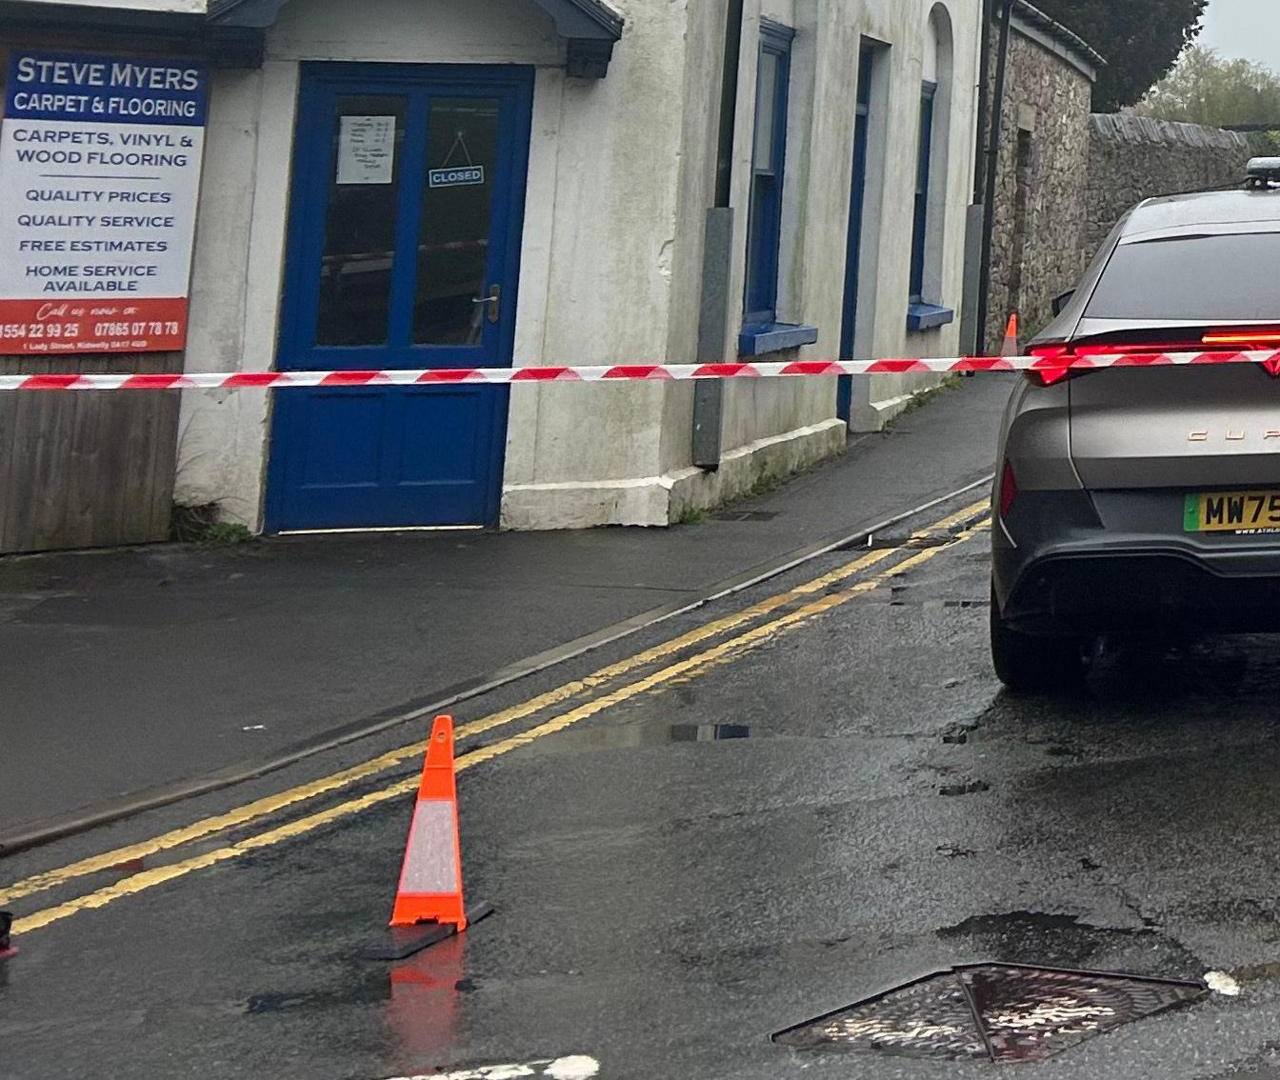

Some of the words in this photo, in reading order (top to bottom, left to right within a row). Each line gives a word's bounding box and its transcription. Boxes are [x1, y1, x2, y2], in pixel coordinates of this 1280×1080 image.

[17, 57, 105, 86] STEVE
[110, 63, 199, 91] MYERS
[14, 92, 89, 113] CARPET
[92, 96, 104, 113] &
[108, 97, 196, 117] FLOORING
[120, 133, 175, 147] VINYL
[180, 135, 193, 147] &
[16, 149, 82, 164] WOOD
[87, 152, 187, 167] FLOORING
[432, 170, 480, 183] CLOSED
[26, 189, 104, 203] QUALITY
[108, 191, 172, 203] PRICES
[17, 215, 97, 227] QUALITY
[100, 216, 174, 228] SERVICE
[19, 240, 66, 252] FREE
[70, 240, 168, 252] ESTIMATES
[26, 265, 79, 276] HOME
[83, 265, 157, 276] SERVICE
[43, 280, 138, 292] AVAILABLE
[36, 303, 68, 321] Call
[28, 323, 44, 338] 22
[64, 322, 79, 337] 25
[131, 322, 146, 335] 07
[148, 322, 162, 335] 78
[165, 321, 178, 335] 78
